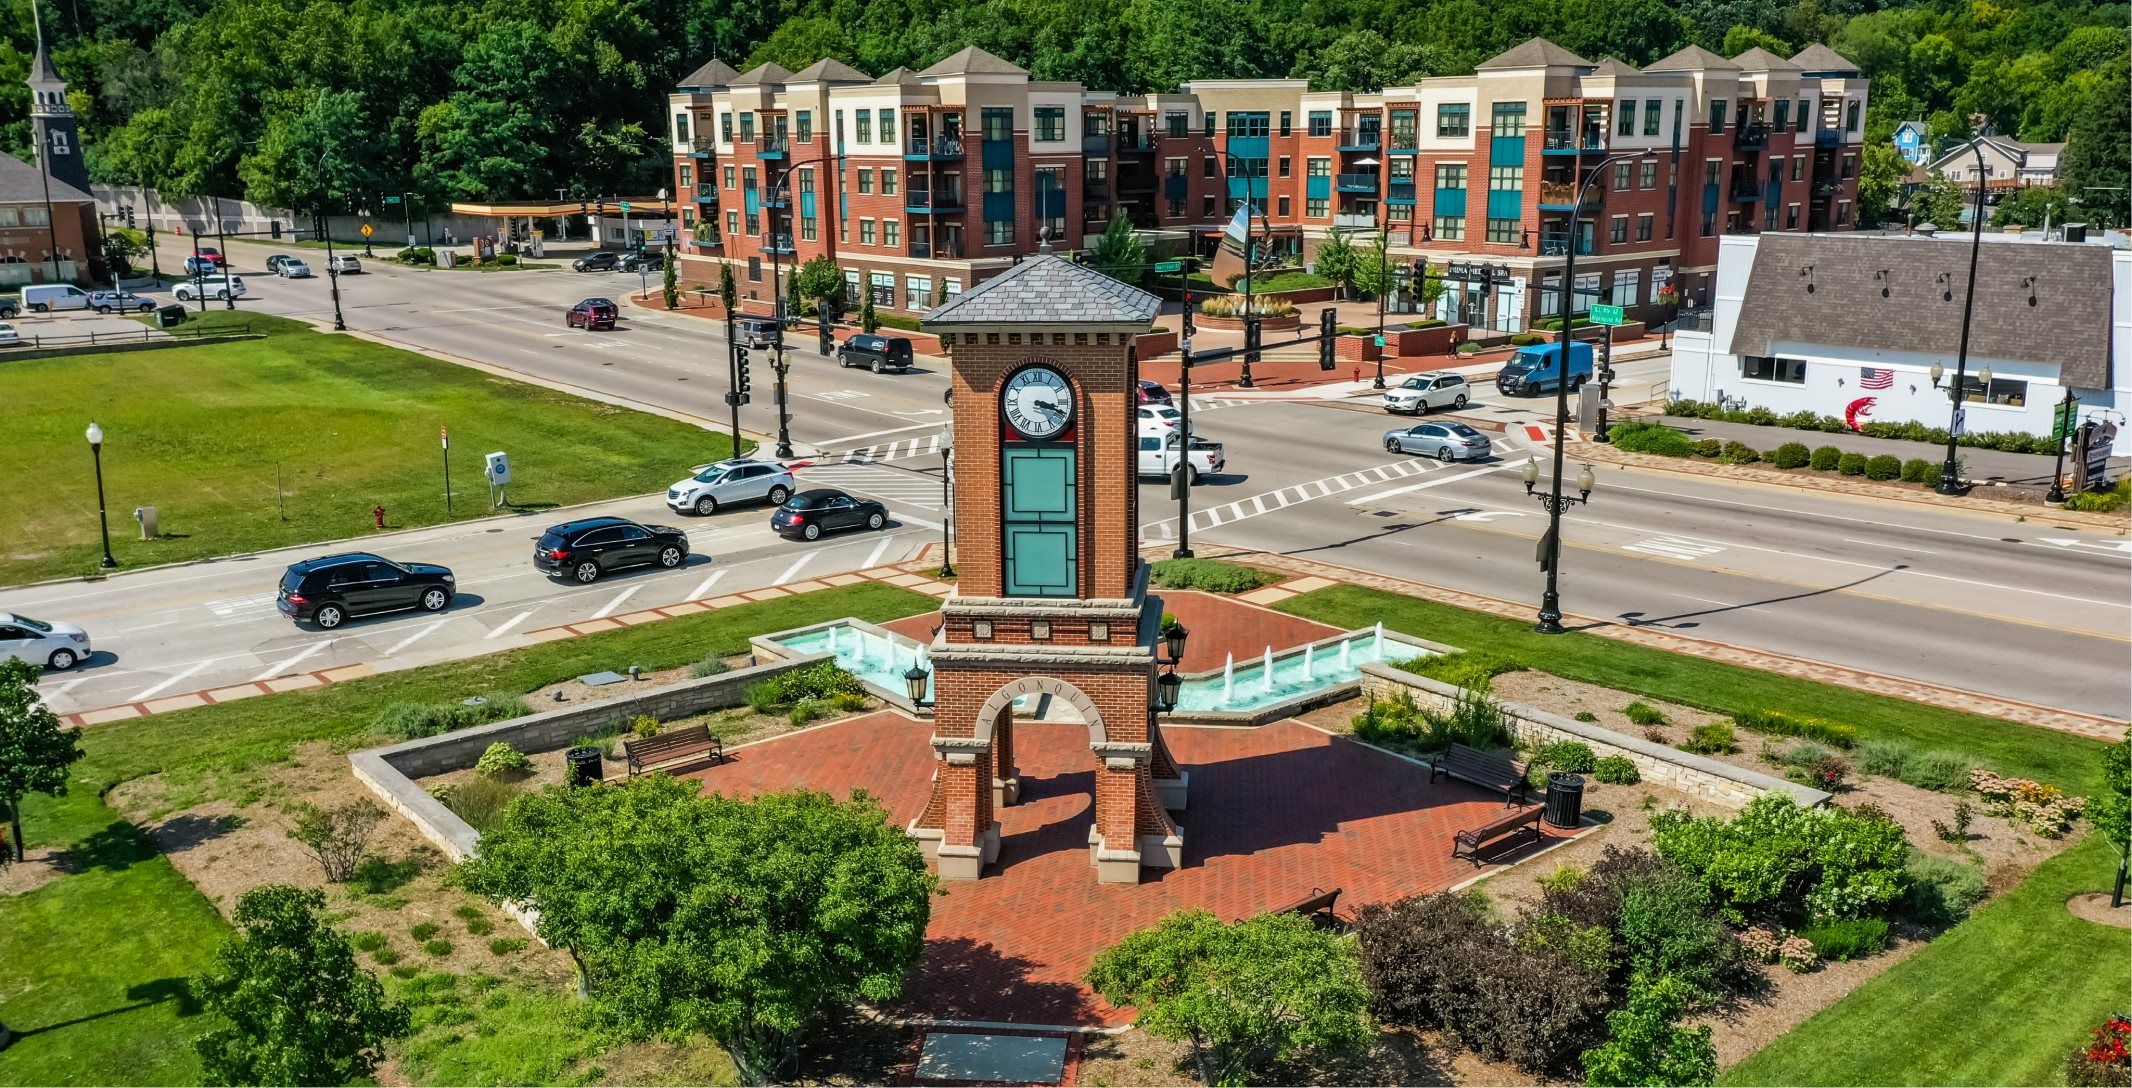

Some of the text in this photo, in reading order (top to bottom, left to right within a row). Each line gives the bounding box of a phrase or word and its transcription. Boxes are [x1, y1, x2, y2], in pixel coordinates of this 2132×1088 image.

[1449, 266, 1468, 274] PRIMA
[1497, 269, 1508, 277] SPA
[1033, 372, 1043, 383] XII
[981, 679, 1100, 728] ALGONQUIN
